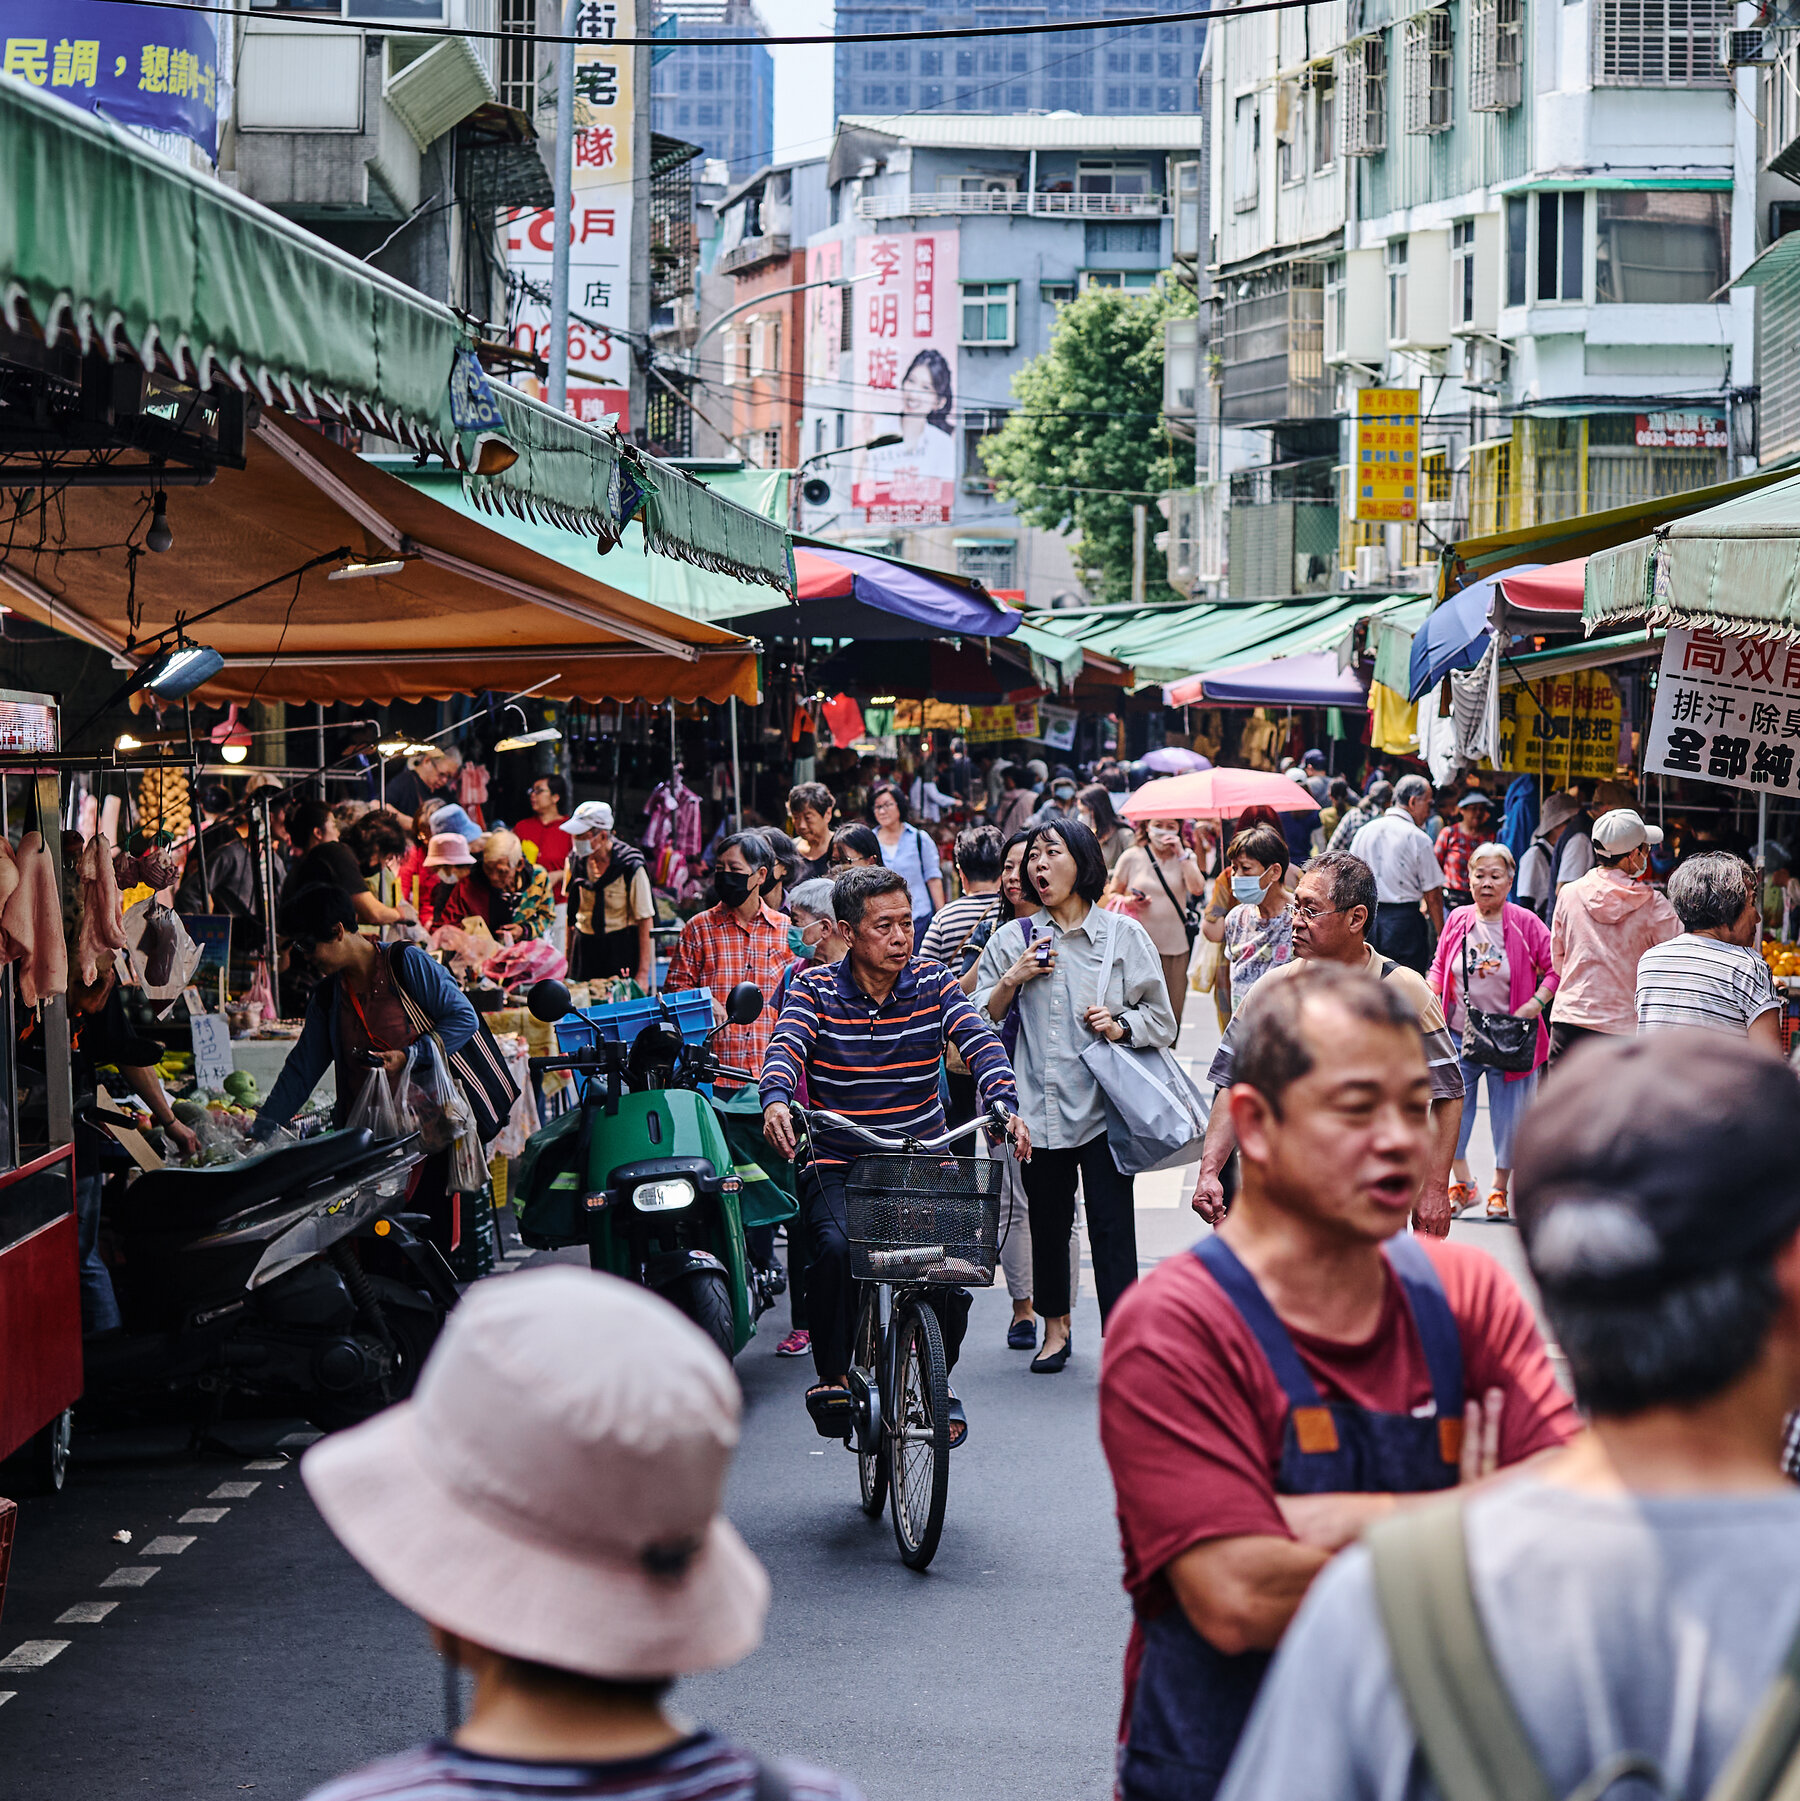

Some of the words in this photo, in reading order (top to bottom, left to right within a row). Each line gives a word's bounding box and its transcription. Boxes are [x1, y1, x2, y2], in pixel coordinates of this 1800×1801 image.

[575, 62, 617, 105] 宅
[583, 280, 611, 308] 店
[1663, 727, 1800, 789] 全部純
